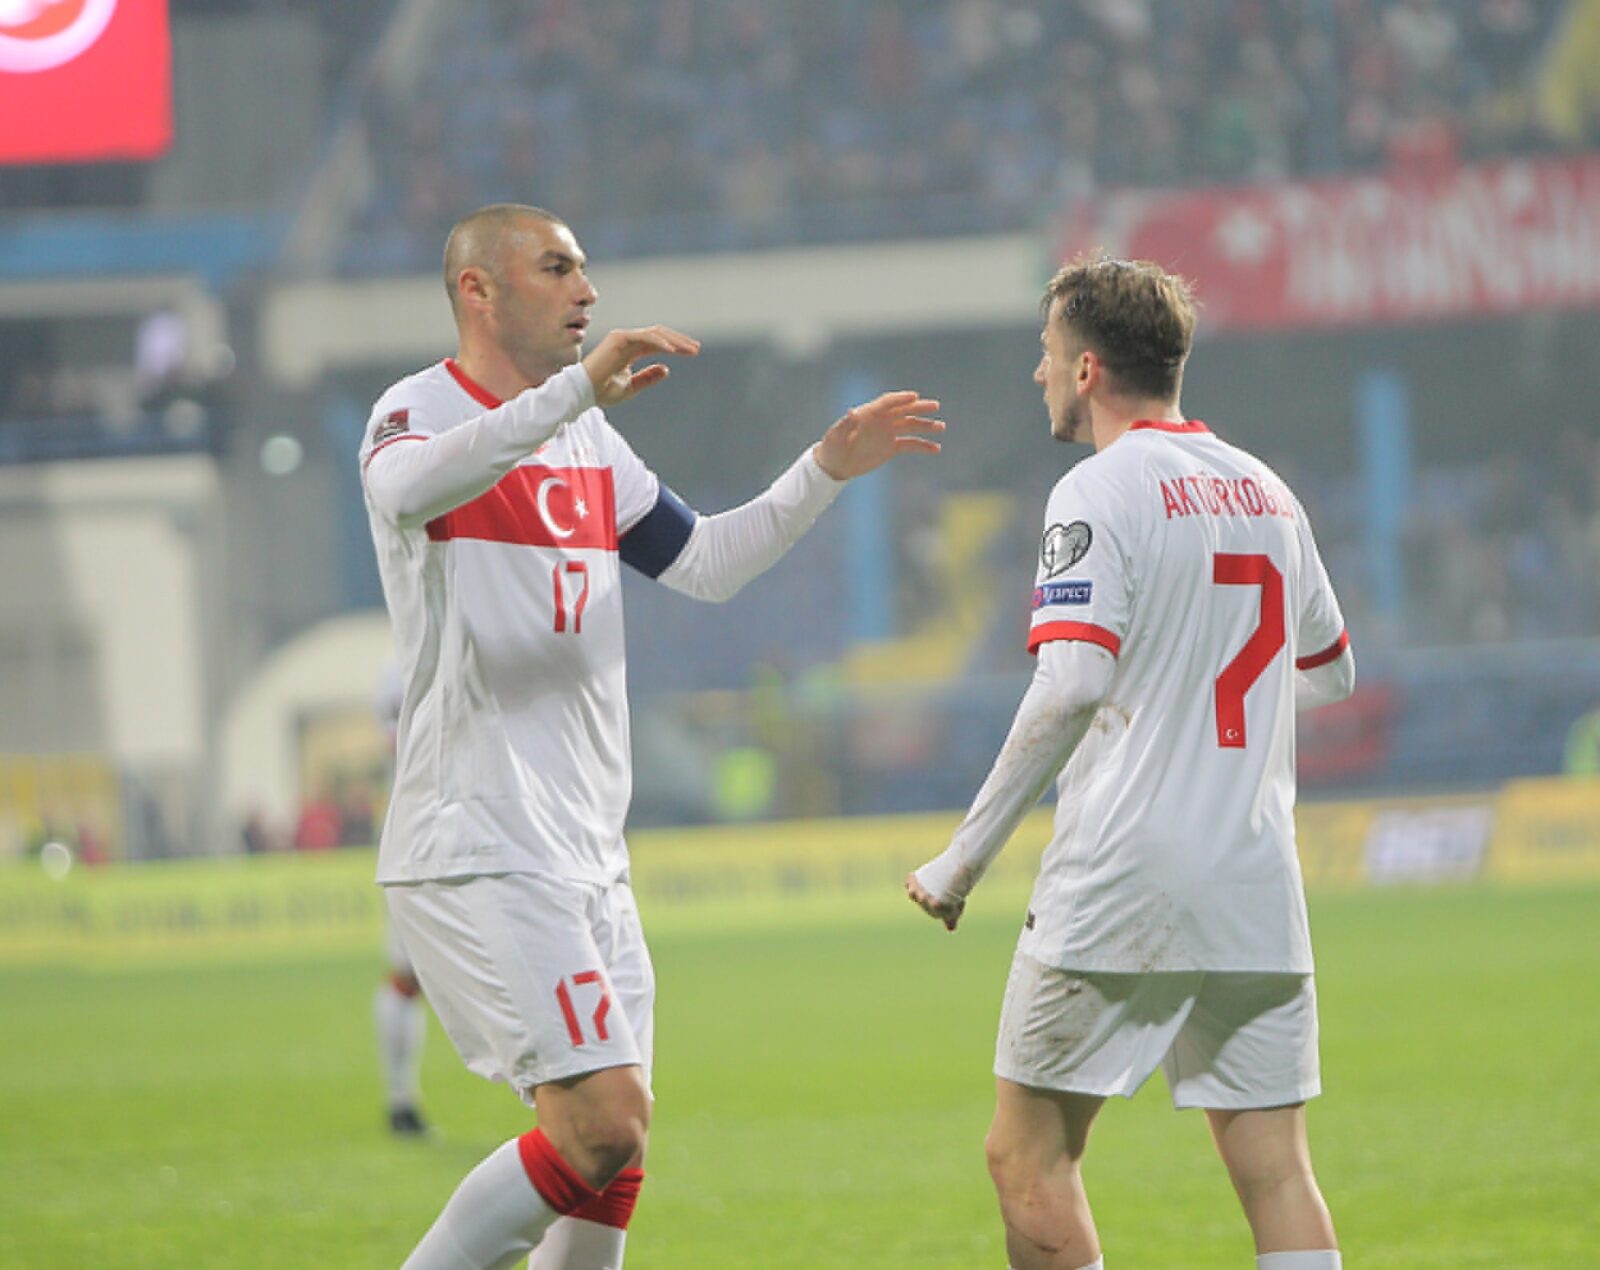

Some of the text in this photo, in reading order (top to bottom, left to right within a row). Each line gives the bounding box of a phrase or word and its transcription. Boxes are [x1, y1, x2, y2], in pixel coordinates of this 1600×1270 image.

[1159, 470, 1294, 520] AKTÜRKOĞ
[553, 560, 589, 633] 17
[1213, 553, 1285, 749] 7
[555, 970, 611, 1047] 17
